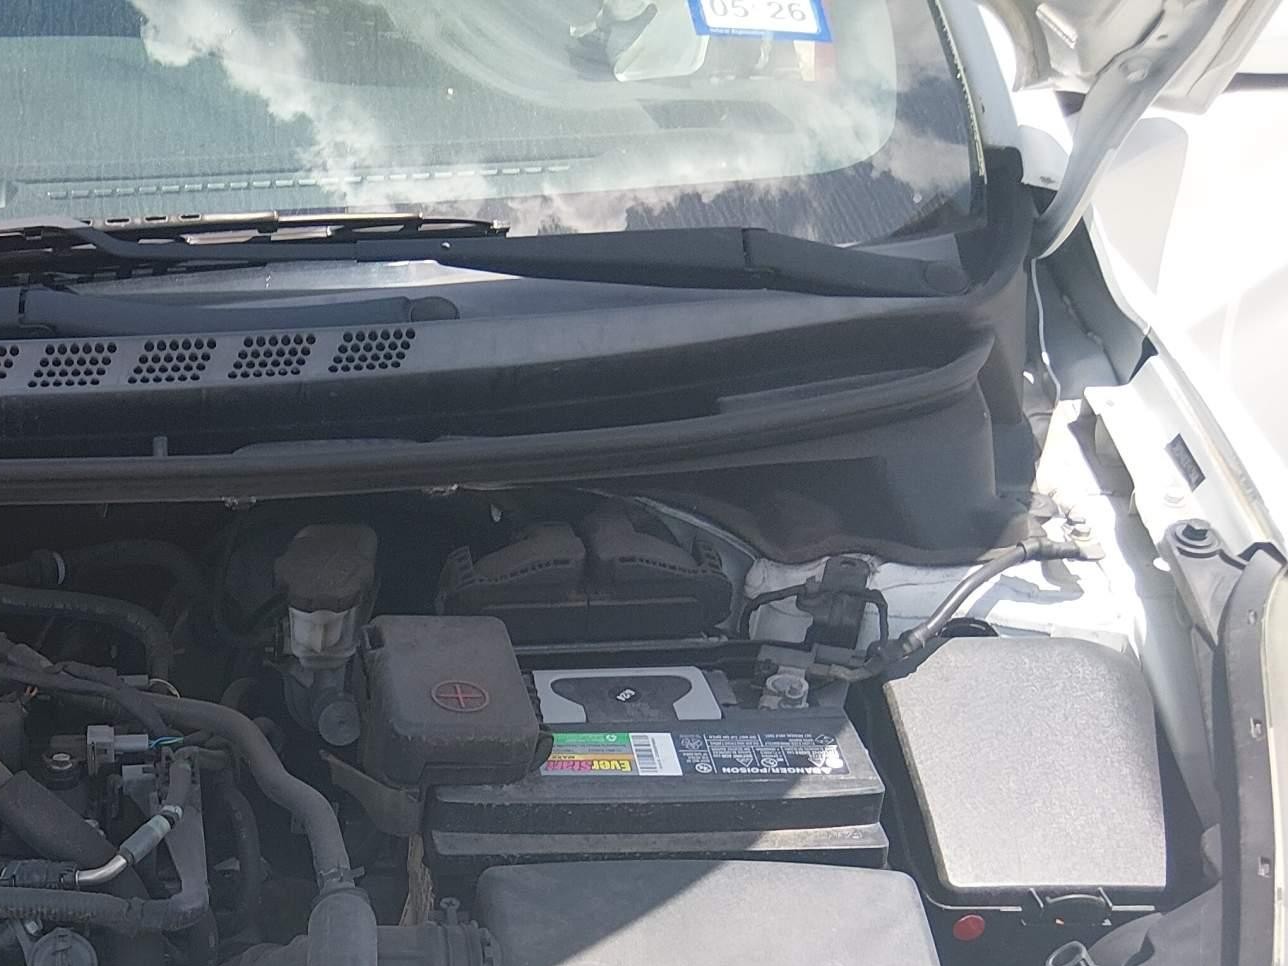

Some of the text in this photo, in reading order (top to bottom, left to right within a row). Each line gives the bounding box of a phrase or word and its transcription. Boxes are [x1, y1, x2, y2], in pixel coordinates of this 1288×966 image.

[710, 0, 806, 22] 05 26
[546, 760, 632, 773] EverStart
